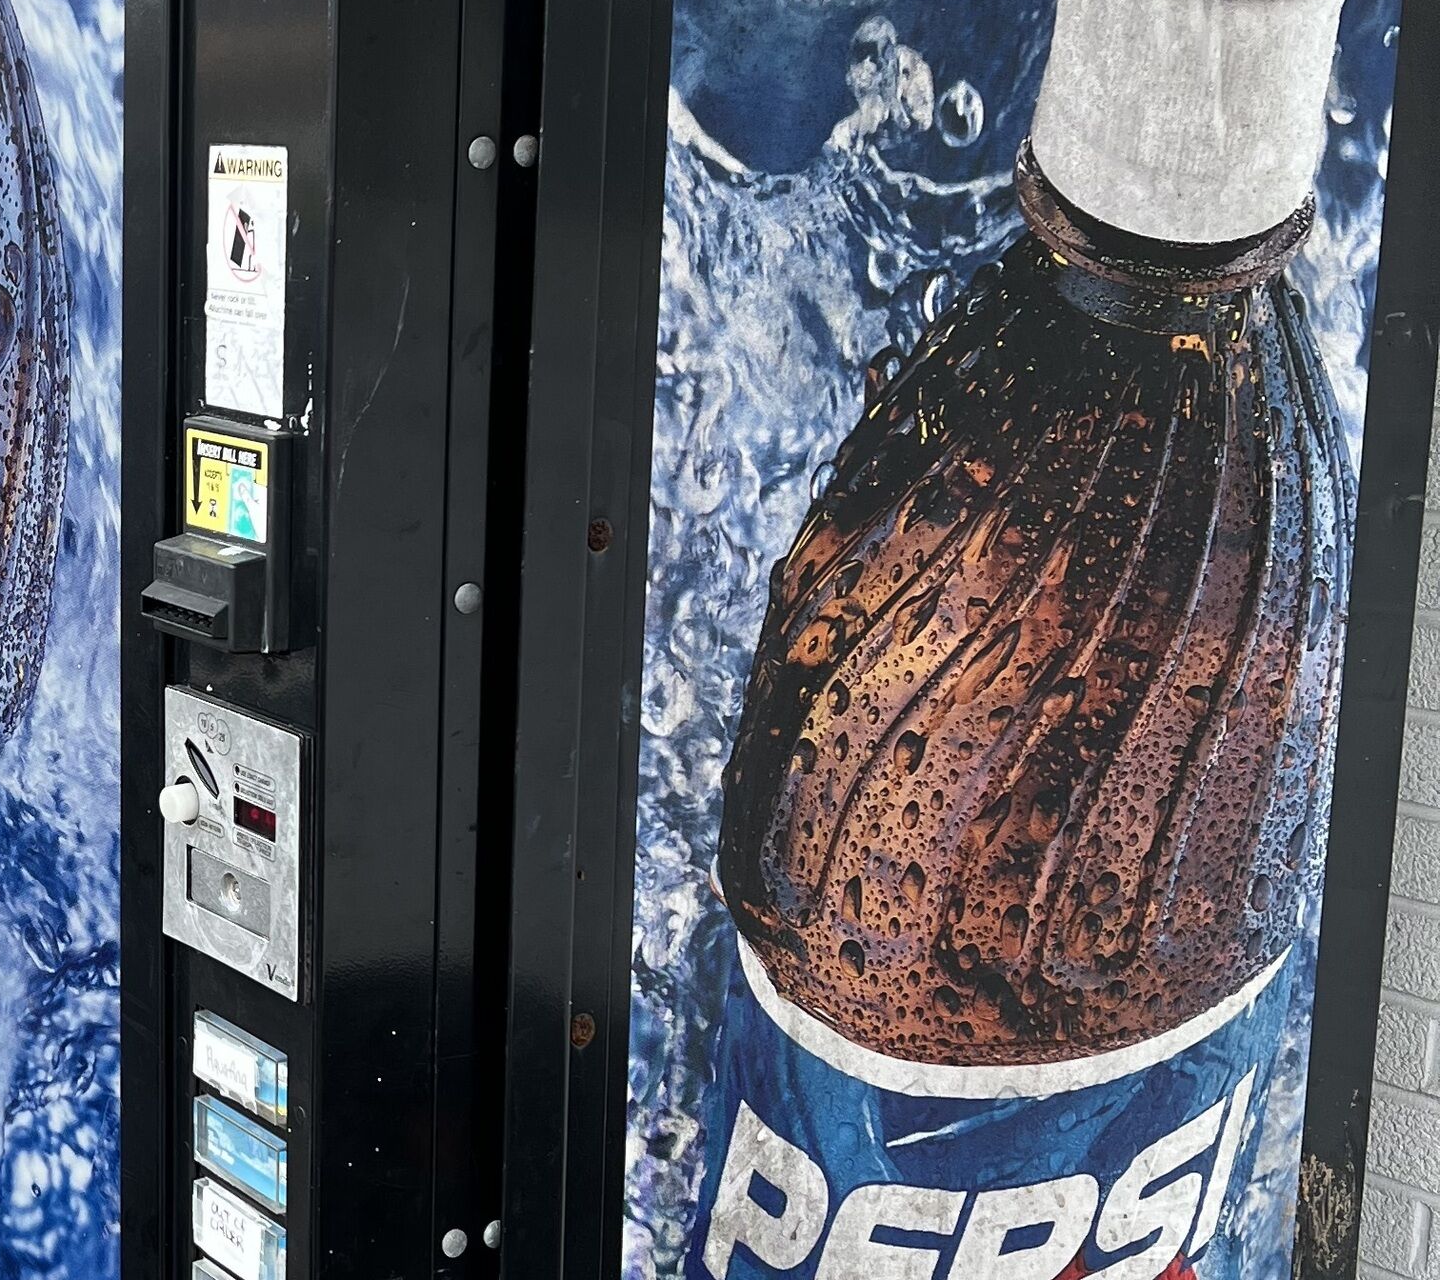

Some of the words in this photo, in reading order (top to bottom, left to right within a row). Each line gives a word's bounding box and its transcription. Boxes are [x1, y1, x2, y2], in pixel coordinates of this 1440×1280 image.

[227, 157, 283, 178] WARNING
[197, 438, 222, 460] INSERT
[222, 446, 238, 463] BILL
[238, 450, 258, 468] HERE
[211, 1201, 230, 1223] OUT
